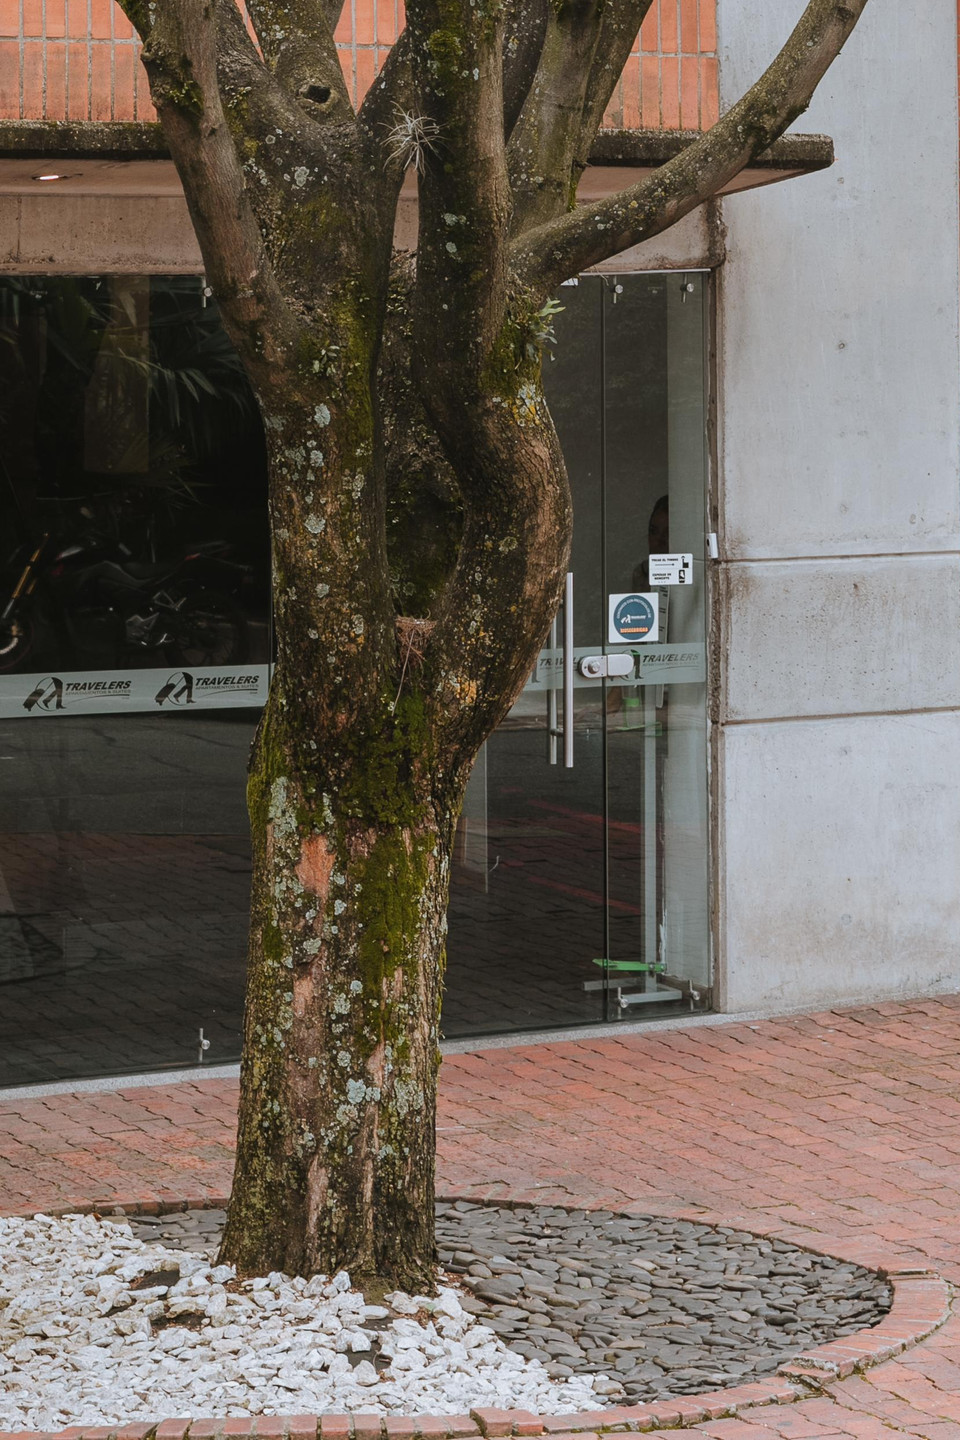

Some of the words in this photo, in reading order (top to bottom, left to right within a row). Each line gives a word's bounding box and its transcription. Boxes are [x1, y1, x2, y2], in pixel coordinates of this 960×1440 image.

[643, 652, 700, 663] TRAVELERS
[65, 680, 132, 691] TRAVELERS
[195, 675, 260, 686] TRAVELERS
